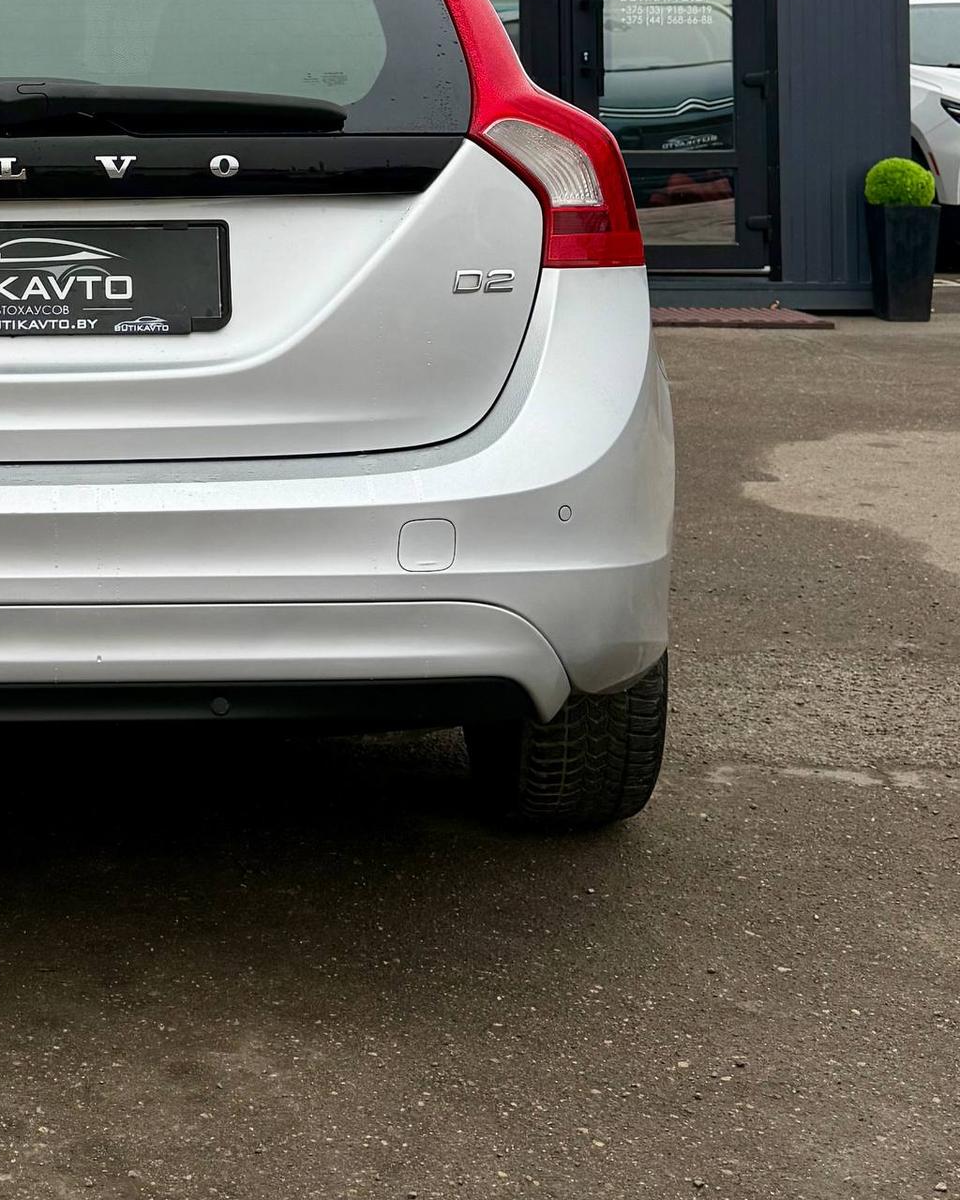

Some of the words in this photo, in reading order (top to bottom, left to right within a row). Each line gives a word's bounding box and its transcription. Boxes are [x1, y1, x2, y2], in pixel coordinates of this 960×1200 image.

[646, 5, 664, 17] (33)
[667, 5, 713, 15] 918-38-19
[621, 16, 643, 25] +375
[646, 15, 664, 27] (44)
[666, 15, 713, 25] 568-66-88
[452, 269, 515, 294] D2
[114, 324, 169, 332] BUTIKAVTO
